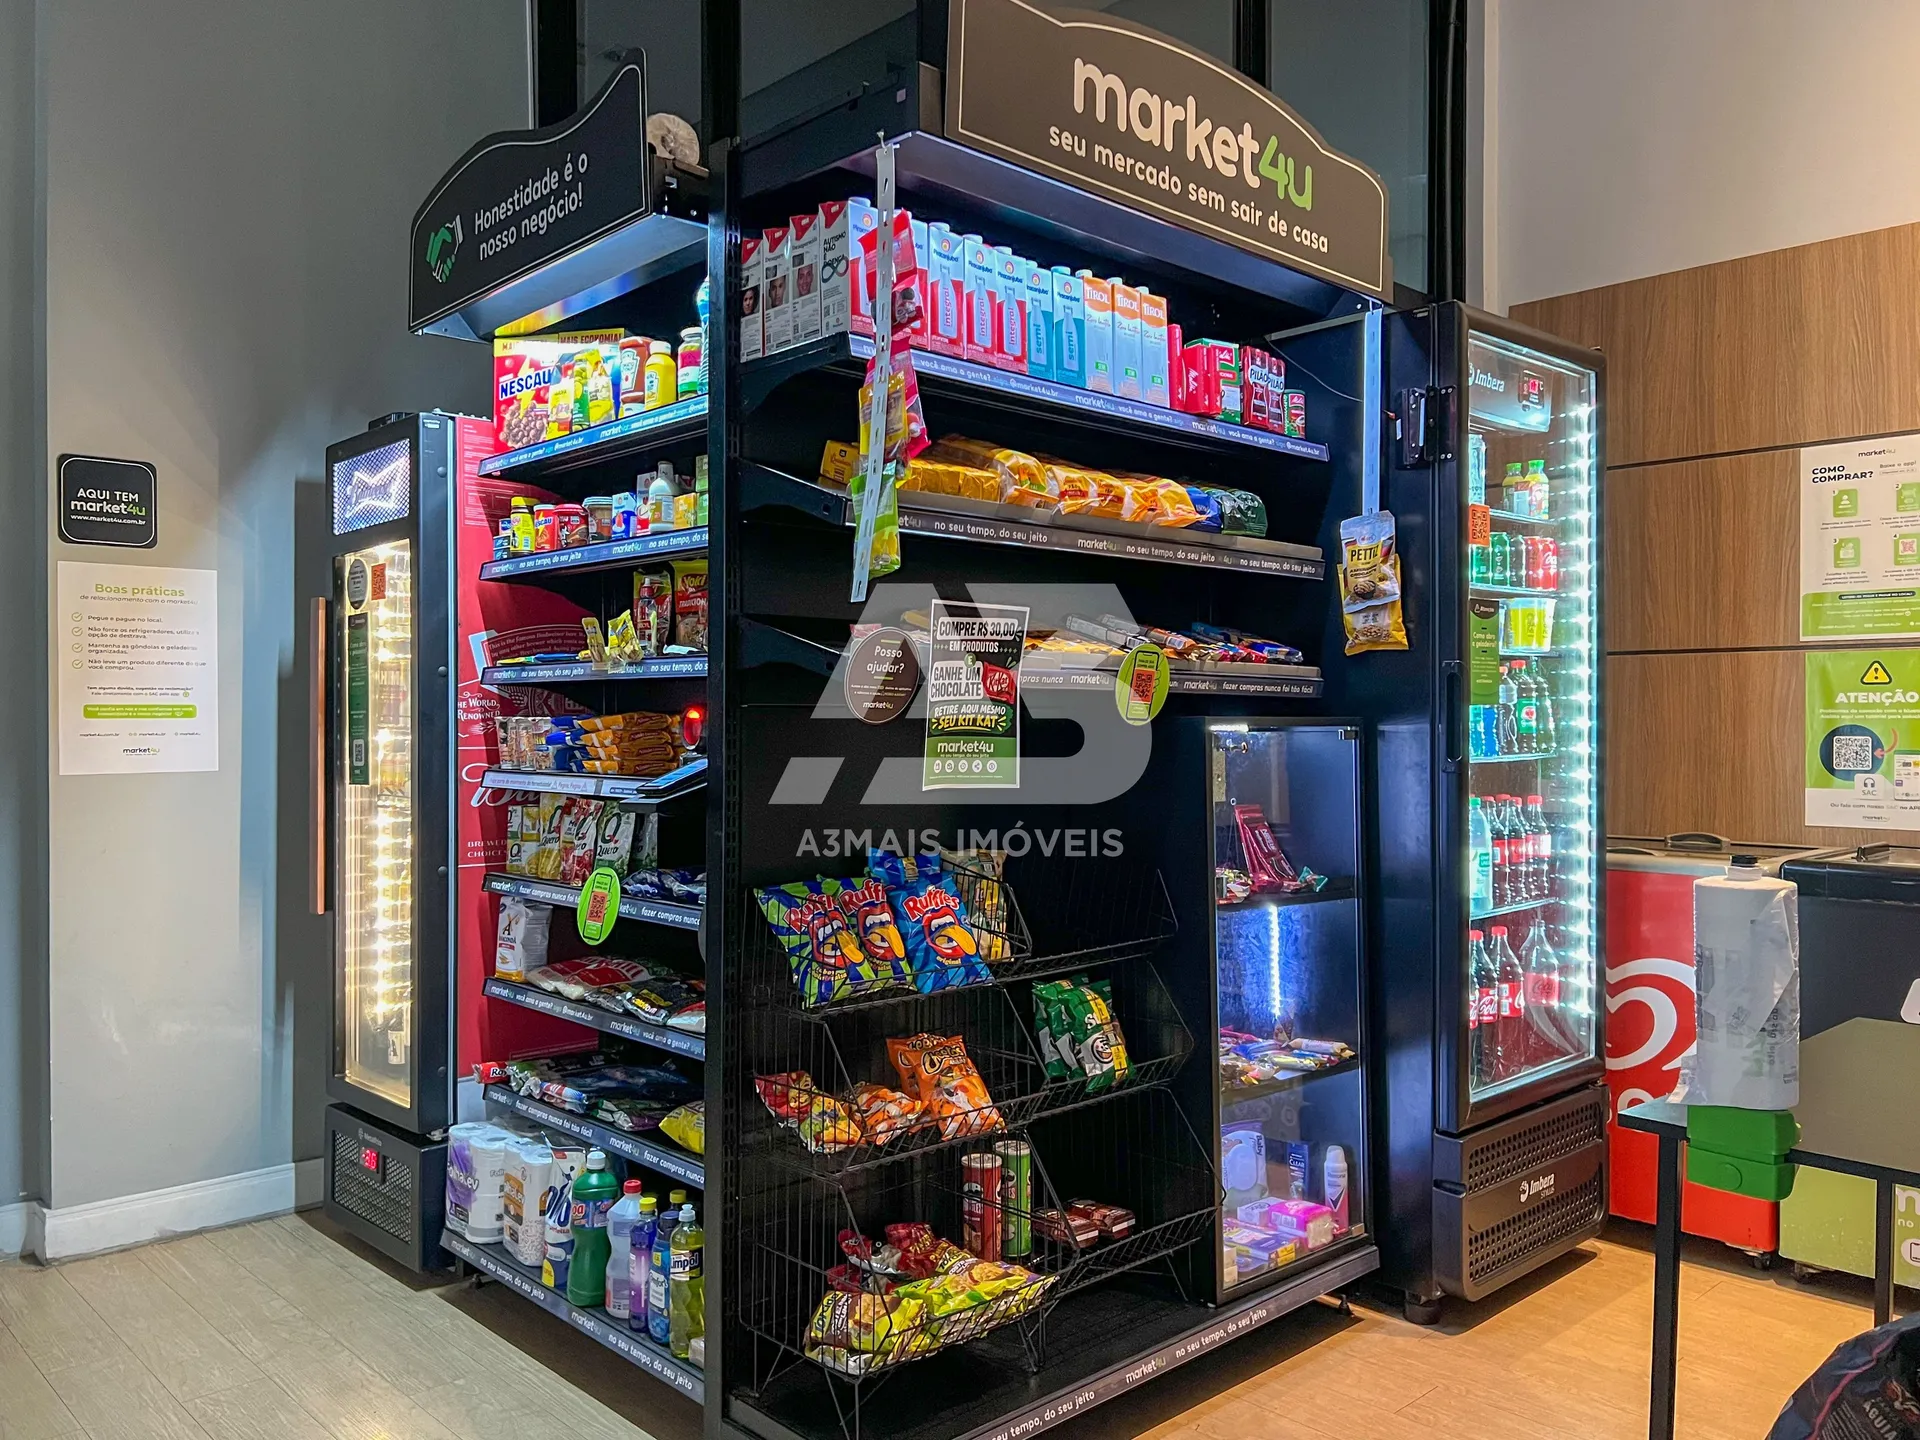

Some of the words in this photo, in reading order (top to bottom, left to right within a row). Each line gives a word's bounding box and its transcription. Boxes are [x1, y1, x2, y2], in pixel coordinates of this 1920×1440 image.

[1073, 57, 1312, 211] market4u
[474, 167, 560, 235] Honestidade
[563, 153, 573, 182] é
[578, 153, 588, 173] o
[1049, 125, 1086, 157] seu
[1094, 143, 1181, 195] mercado
[1188, 183, 1224, 213] sem
[1231, 198, 1262, 228] sair
[1268, 210, 1288, 238] de
[1294, 225, 1328, 253] casa
[479, 227, 517, 261] nosso
[521, 182, 583, 238] negócio!
[1085, 285, 1110, 305] TIROL
[1115, 293, 1139, 313] TIROL
[1142, 302, 1165, 320] TIROL
[1033, 323, 1042, 355] semi
[1068, 331, 1076, 361] semi
[920, 359, 939, 370] você
[941, 366, 958, 375] ama
[966, 371, 991, 383] gente?
[1250, 368, 1268, 383] PILÃO
[500, 369, 551, 399] NESCAU
[1474, 369, 1505, 392] Imbera
[1076, 394, 1115, 409] market4u
[1812, 465, 1846, 475] COMO
[1812, 471, 1874, 484] COMPRAR?
[77, 488, 110, 499] AQUI
[114, 491, 139, 502] TEM
[70, 500, 146, 516] market4u
[70, 514, 146, 525] www.market4u.com.br
[934, 521, 946, 531] no
[949, 523, 964, 533] seu
[967, 523, 997, 539] tempo,
[999, 527, 1011, 538] do
[1012, 529, 1027, 541] seu
[1028, 530, 1048, 543] jeito
[1078, 538, 1117, 551] market4u
[1126, 545, 1136, 554] no
[1137, 546, 1150, 555] seu
[1151, 546, 1175, 559] tempo,
[1176, 550, 1186, 559] do
[1187, 551, 1199, 560] seu
[1199, 551, 1215, 563] jeito
[1239, 558, 1248, 566] no
[1249, 559, 1260, 568] seu
[1261, 559, 1281, 571] tempo,
[1282, 562, 1290, 571] do
[1291, 564, 1301, 572] seu
[1302, 564, 1316, 574] jeito
[95, 583, 128, 594] Boas
[132, 586, 185, 597] práticas
[90, 595, 143, 603] relacionamento
[939, 621, 976, 637] COMPRE
[977, 621, 988, 637] R$
[989, 621, 1015, 638] 30,00
[874, 645, 903, 658] Posso
[949, 641, 961, 652] EM
[961, 641, 999, 653] PRODUTOS
[866, 662, 905, 674] ajudar?
[967, 655, 973, 665] E
[934, 667, 963, 681] GANHE
[966, 667, 981, 681] UM
[1071, 673, 1109, 685] market4u
[931, 682, 982, 698] CHOCOLATE
[1183, 680, 1217, 691] market4u
[1222, 682, 1238, 691] fazer
[1239, 683, 1262, 693] compras
[1263, 684, 1281, 693] nunca
[1282, 683, 1290, 693] foi
[1291, 684, 1300, 693] tão
[1301, 684, 1313, 694] fácil
[863, 701, 894, 710] market4u
[1835, 689, 1919, 706] ATENÇÃO
[934, 704, 958, 717] RETIRE
[961, 704, 979, 715] AQUI
[980, 704, 1006, 715] MESMO
[939, 717, 958, 730] SEU
[959, 716, 975, 728] KIT
[977, 716, 997, 728] KAT
[937, 740, 994, 754] market4u
[902, 889, 960, 922] Ruffles
[515, 1101, 528, 1114] fazer
[528, 1106, 548, 1121] compras
[548, 1113, 563, 1126] nunca
[580, 1124, 593, 1139] fácil
[609, 1136, 639, 1156] market4u
[1529, 1173, 1555, 1196] Imbera
[497, 1264, 514, 1284] tempo,
[531, 1285, 545, 1300] jeito
[1125, 1356, 1166, 1384] market4u
[1175, 1347, 1186, 1359] no
[1187, 1341, 1200, 1354] seu
[1200, 1328, 1227, 1350] tempo,
[1227, 1322, 1238, 1335] do
[1238, 1317, 1251, 1330] seu
[1250, 1308, 1268, 1327] jeito
[608, 1333, 617, 1345] no
[618, 1338, 629, 1352] seu
[630, 1345, 652, 1368] tempo,
[653, 1359, 662, 1372] do
[663, 1366, 675, 1379] seu
[675, 1370, 693, 1390] jeito
[1009, 1414, 1043, 1440] tempo,
[1044, 1406, 1056, 1422] do
[1057, 1401, 1074, 1416] seu
[1075, 1389, 1096, 1410] jeito
